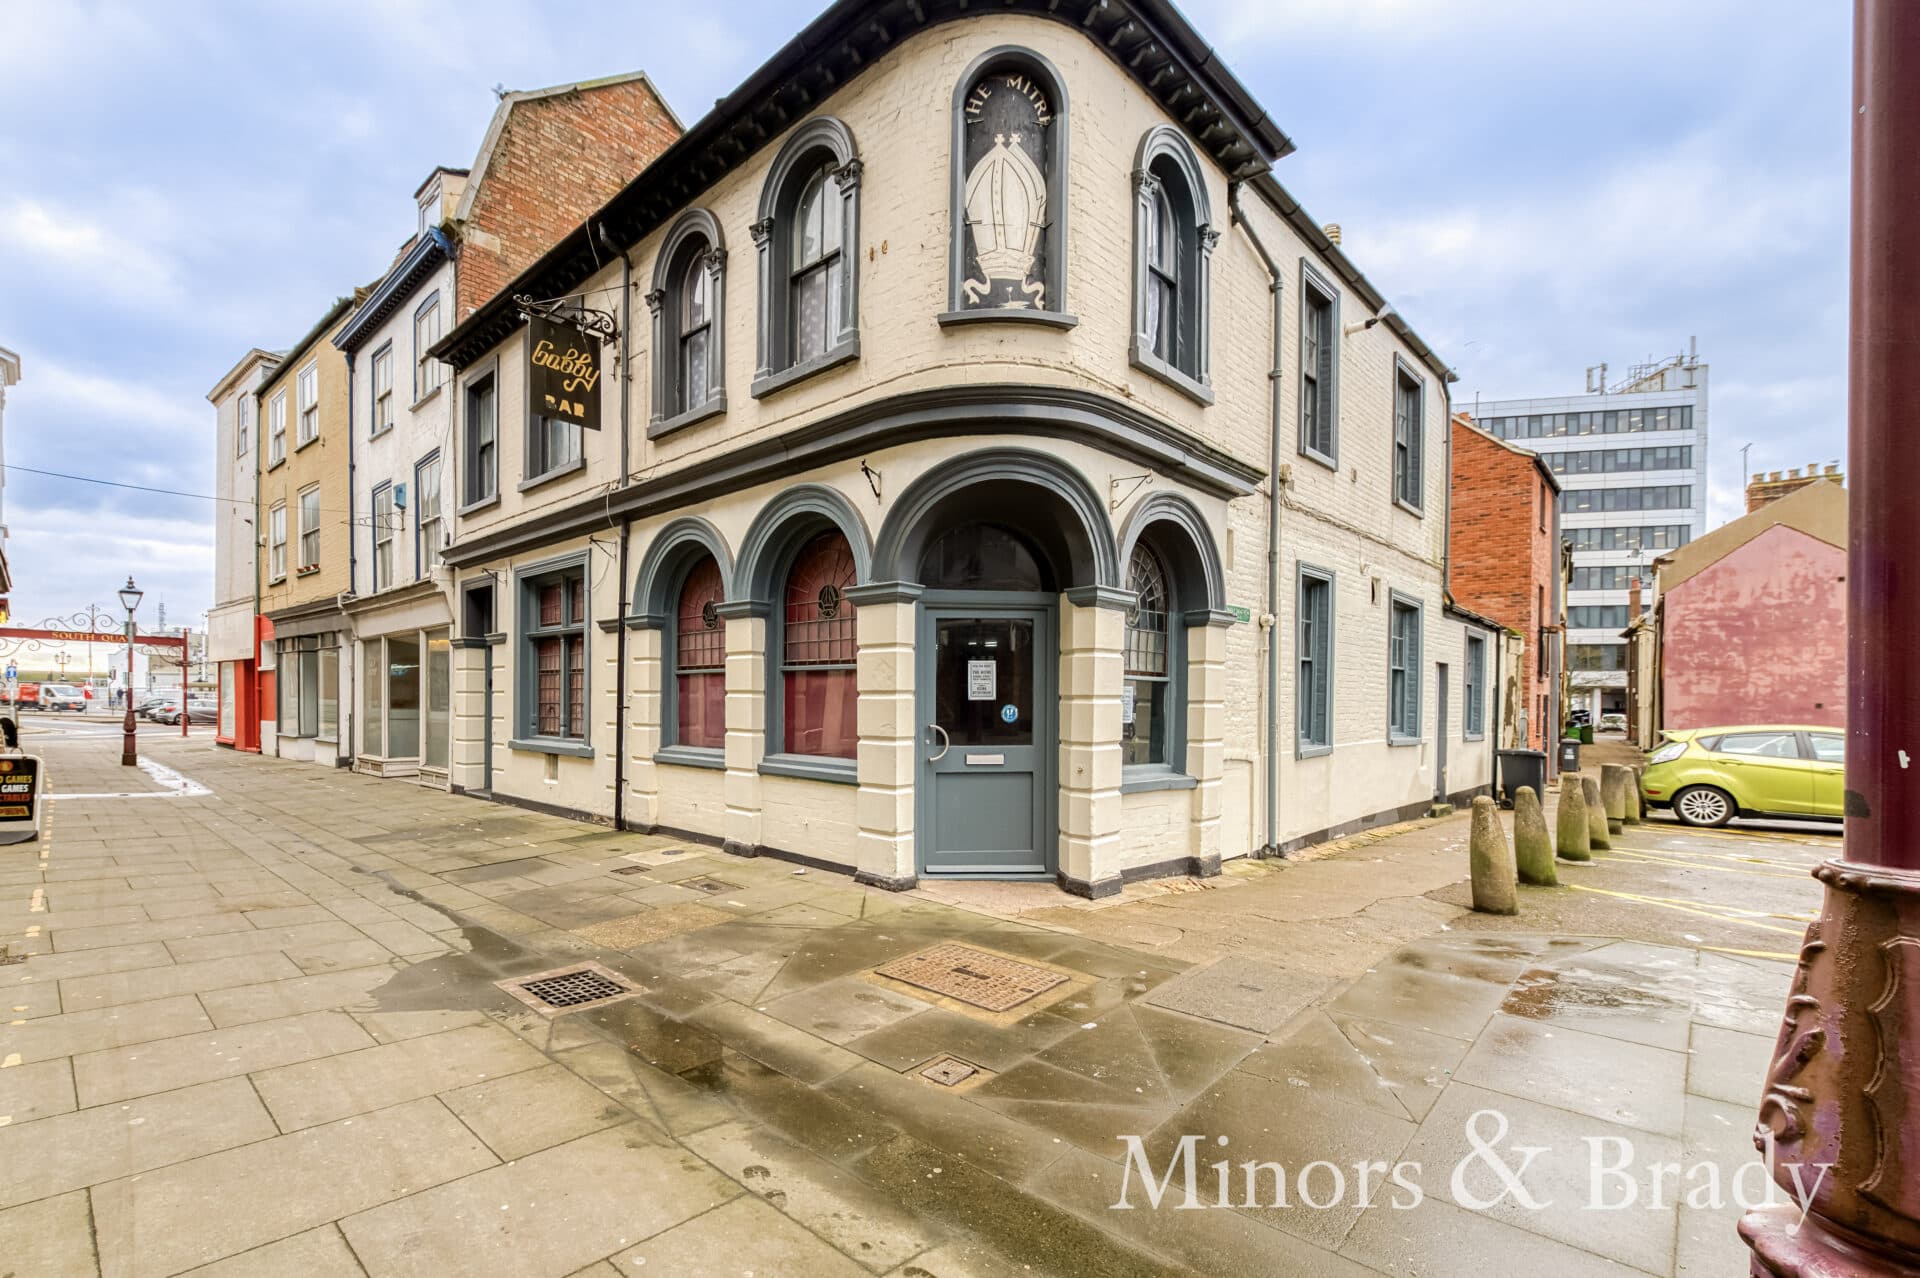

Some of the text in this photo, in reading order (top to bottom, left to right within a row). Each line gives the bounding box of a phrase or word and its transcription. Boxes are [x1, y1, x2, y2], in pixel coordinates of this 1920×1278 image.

[965, 83, 992, 115] HE
[532, 340, 600, 392] Gabby
[51, 631, 129, 643] SOUTH QUA
[5, 775, 33, 784] GAMES
[1, 784, 29, 793] GAMES
